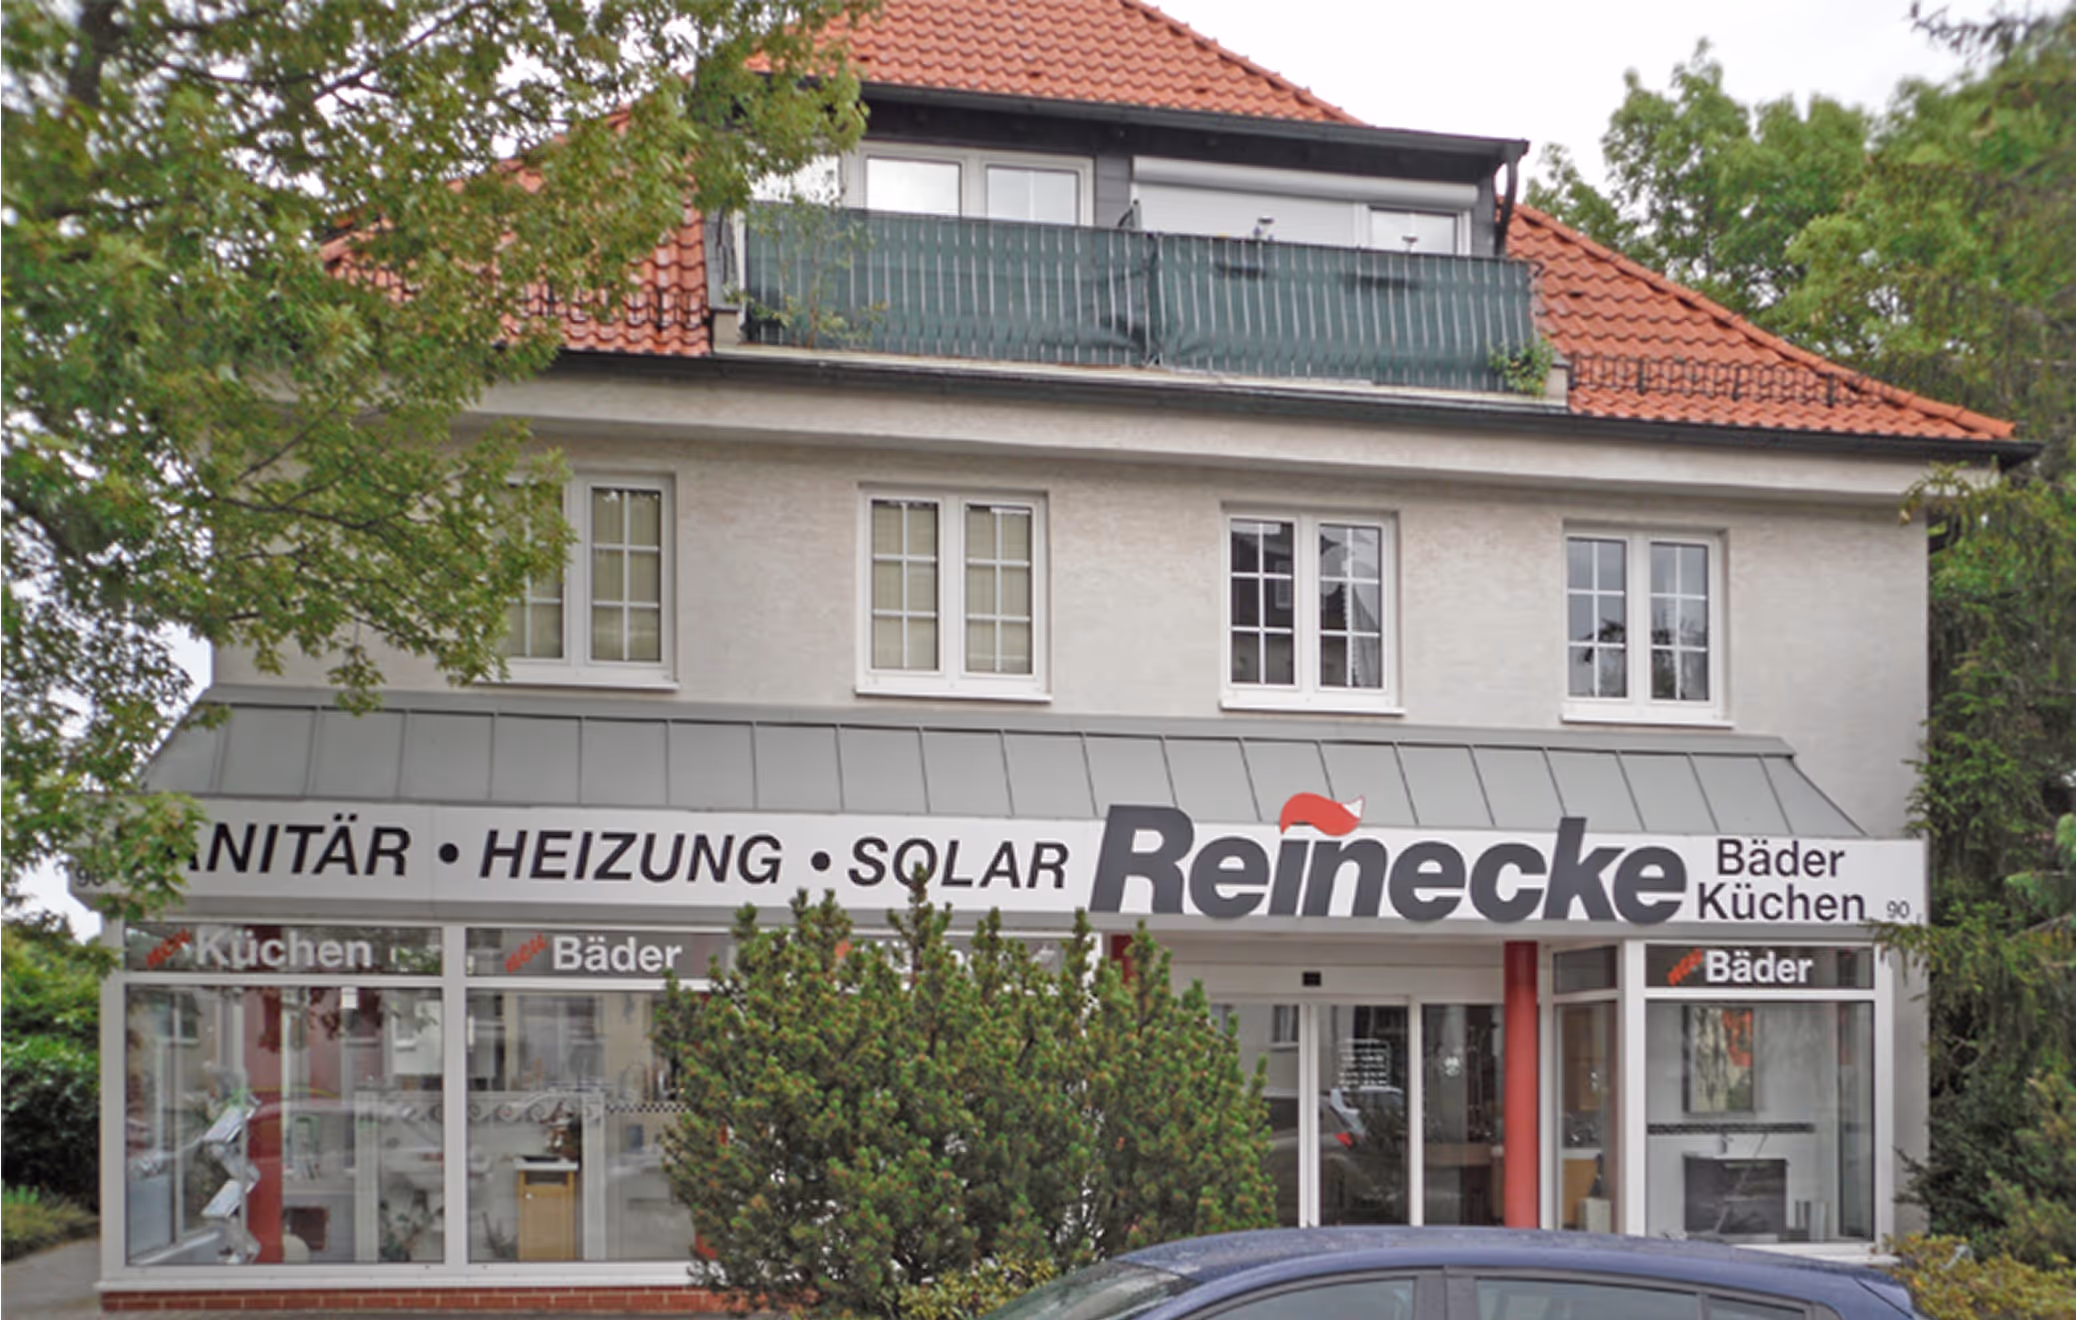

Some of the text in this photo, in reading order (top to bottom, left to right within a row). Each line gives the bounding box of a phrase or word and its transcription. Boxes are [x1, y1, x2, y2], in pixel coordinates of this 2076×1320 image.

[188, 812, 1070, 888] NITÄR HEIZUNG SOLAR
[1088, 804, 1687, 923] Reinecke
[1716, 838, 1846, 878] Bäder
[1697, 881, 1866, 922] Küchen
[1886, 900, 1911, 919] 90
[195, 928, 373, 969] Küchen
[552, 935, 683, 973] Bäder
[1705, 949, 1814, 984] Bäder
